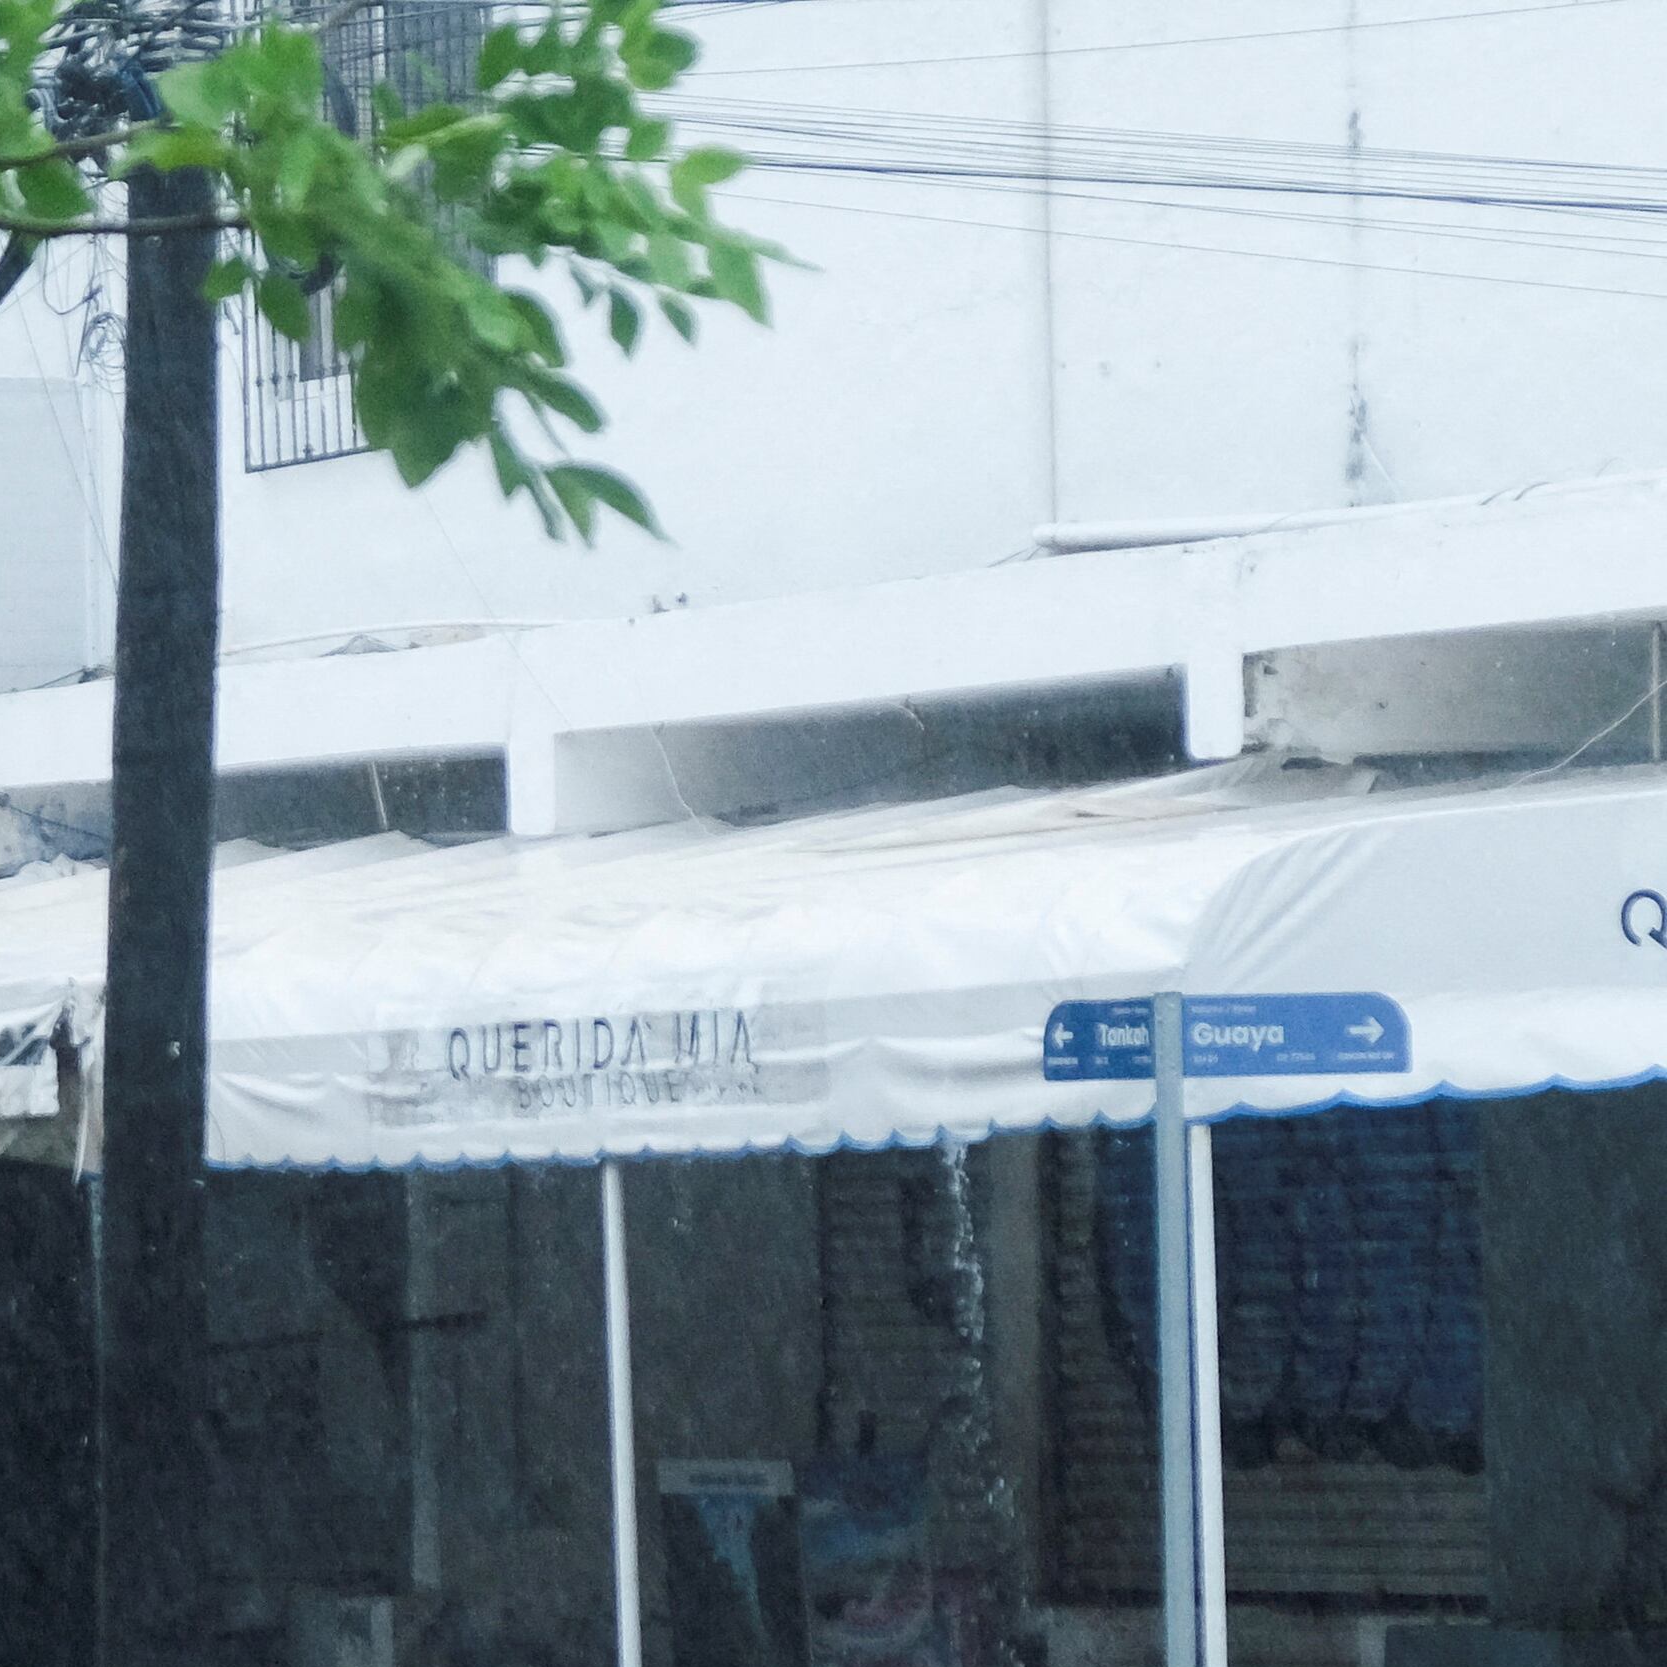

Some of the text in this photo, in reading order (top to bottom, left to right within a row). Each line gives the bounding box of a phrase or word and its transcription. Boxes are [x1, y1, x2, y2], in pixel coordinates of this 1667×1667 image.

[448, 1014, 647, 1081] QUERIDA
[1098, 1023, 1150, 1047] Tankah
[1192, 1022, 1285, 1053] Guaya
